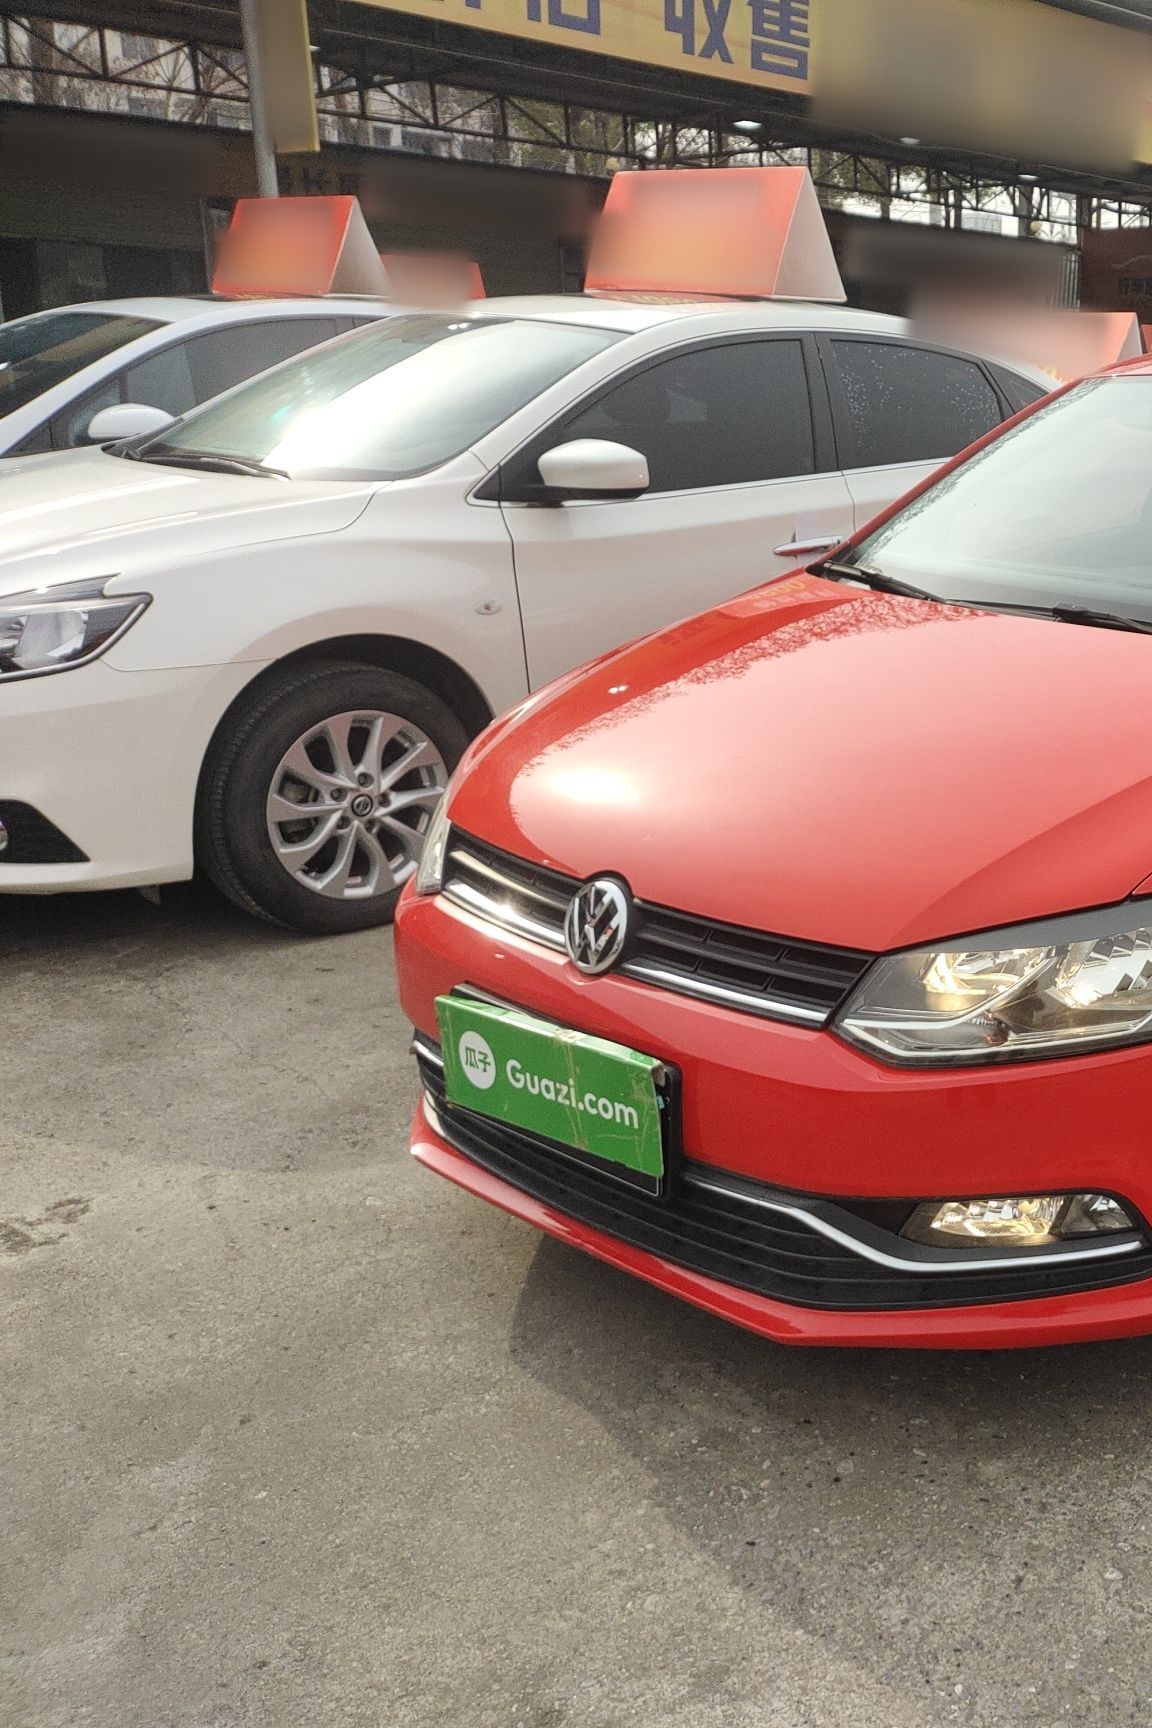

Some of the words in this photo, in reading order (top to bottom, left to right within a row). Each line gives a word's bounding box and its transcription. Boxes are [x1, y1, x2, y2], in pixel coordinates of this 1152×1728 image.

[664, 0, 810, 80] 收售
[464, 1045, 492, 1073] 瓜子
[505, 1058, 640, 1130] Guazi.com
